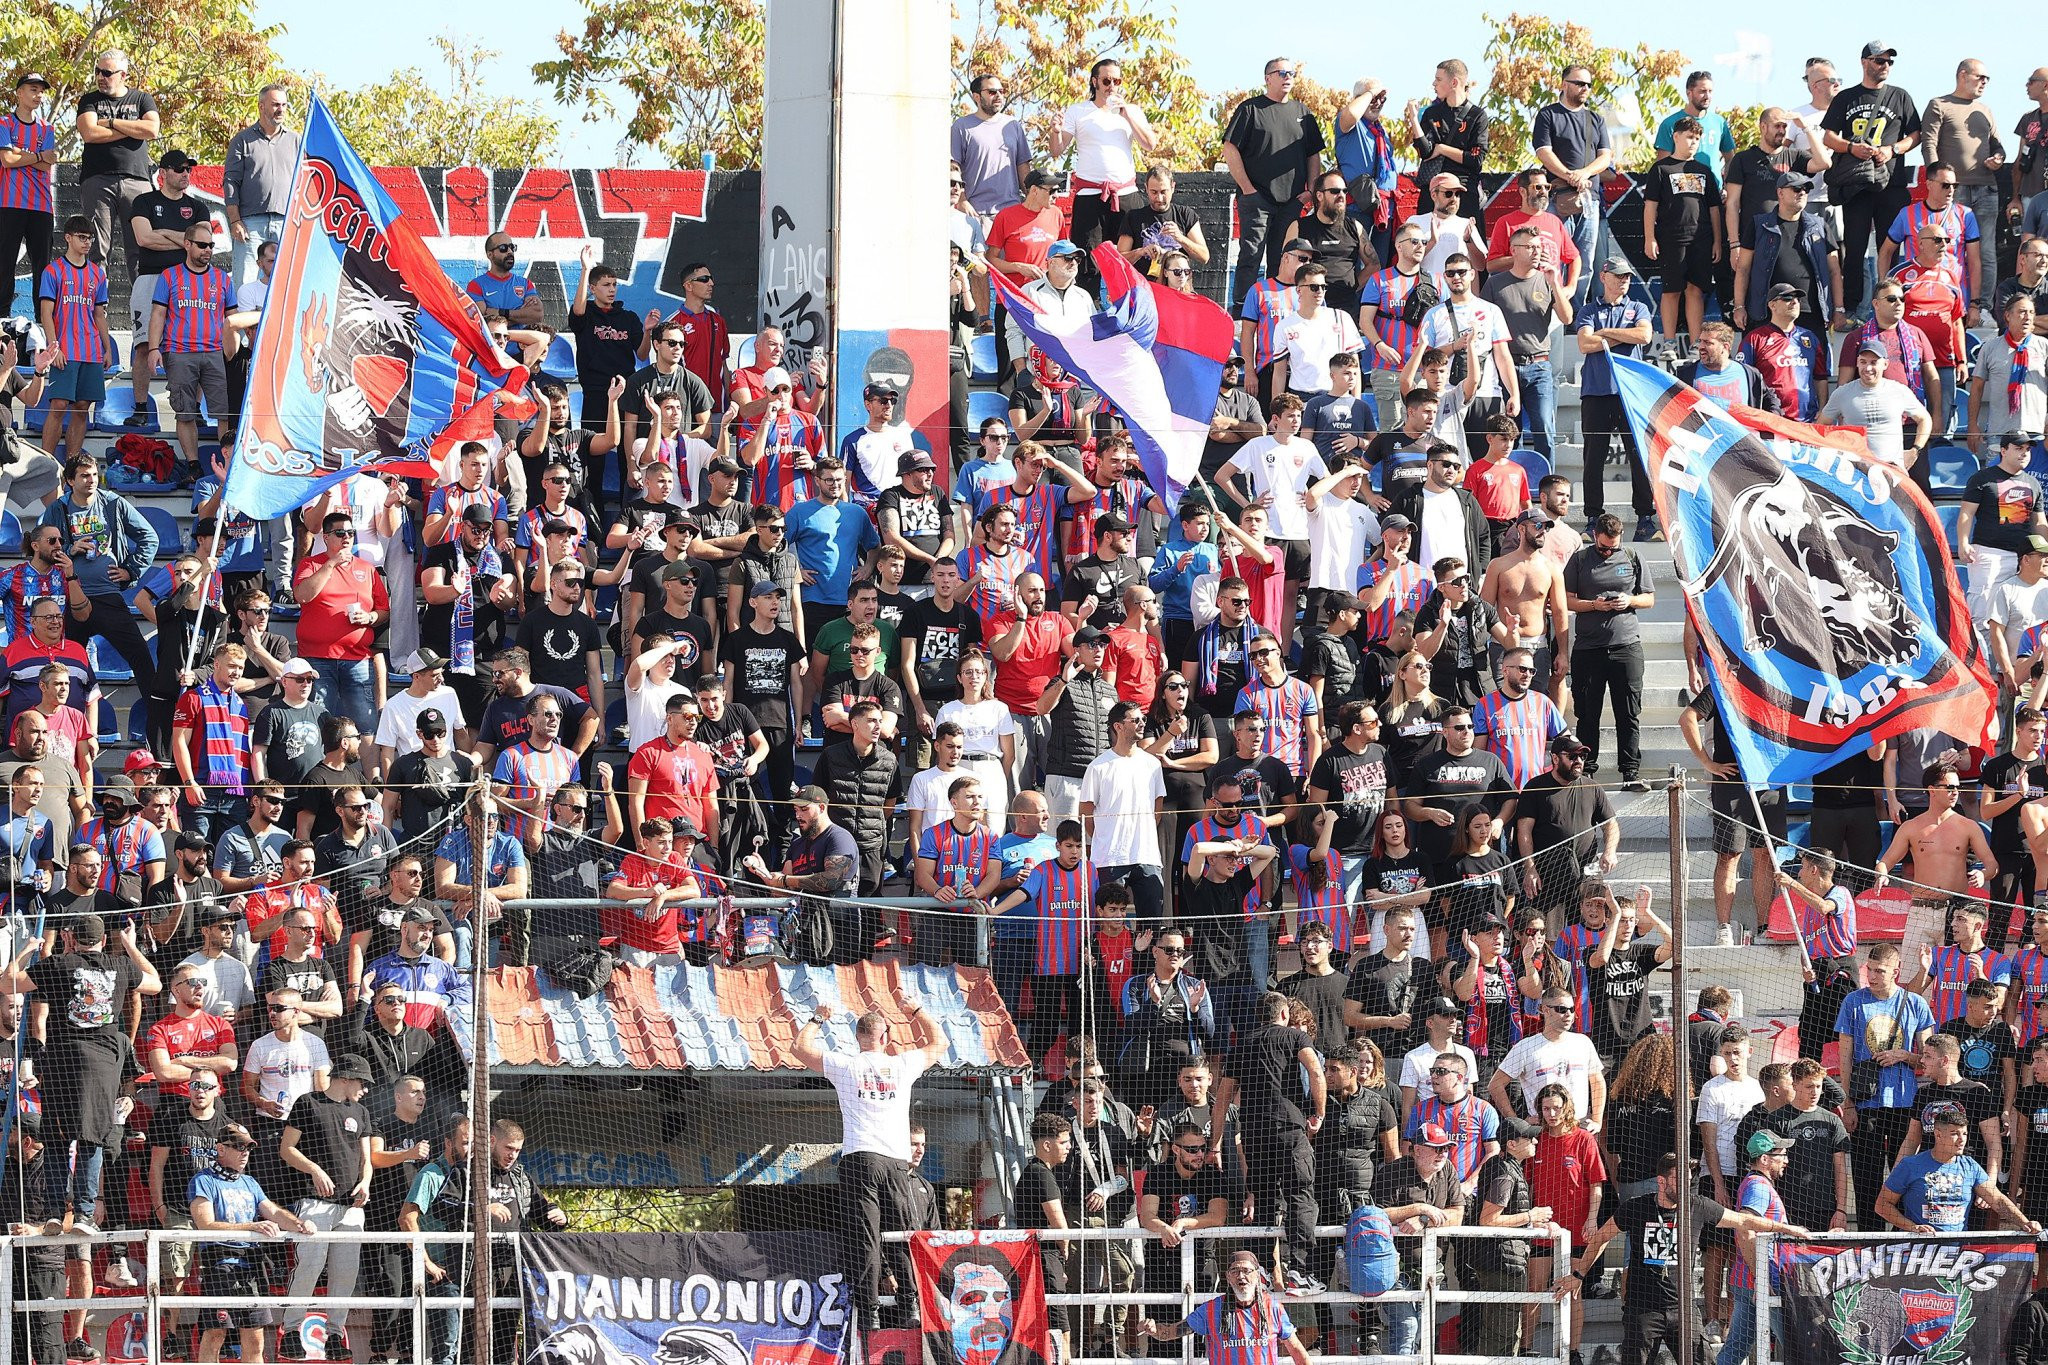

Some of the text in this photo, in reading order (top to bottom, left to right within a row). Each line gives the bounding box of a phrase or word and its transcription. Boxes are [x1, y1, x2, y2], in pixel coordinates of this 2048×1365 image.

[178, 297, 218, 311] panthers
[1776, 354, 1809, 367] Costa
[2008, 490, 2025, 499] NIKE
[901, 498, 938, 517] FCK
[902, 515, 941, 532] NZS
[925, 630, 960, 648] FCK
[923, 645, 960, 660] NZS
[1340, 763, 1376, 783] SILENCE
[1811, 1242, 2007, 1299] PANTHERS
[546, 1270, 844, 1326] ΠΑΝΙΩΝΙΟΣ
[1905, 1296, 1954, 1311] ΠΑΝΙΩΝΙΟΣ
[1222, 1333, 1270, 1350] panthers
